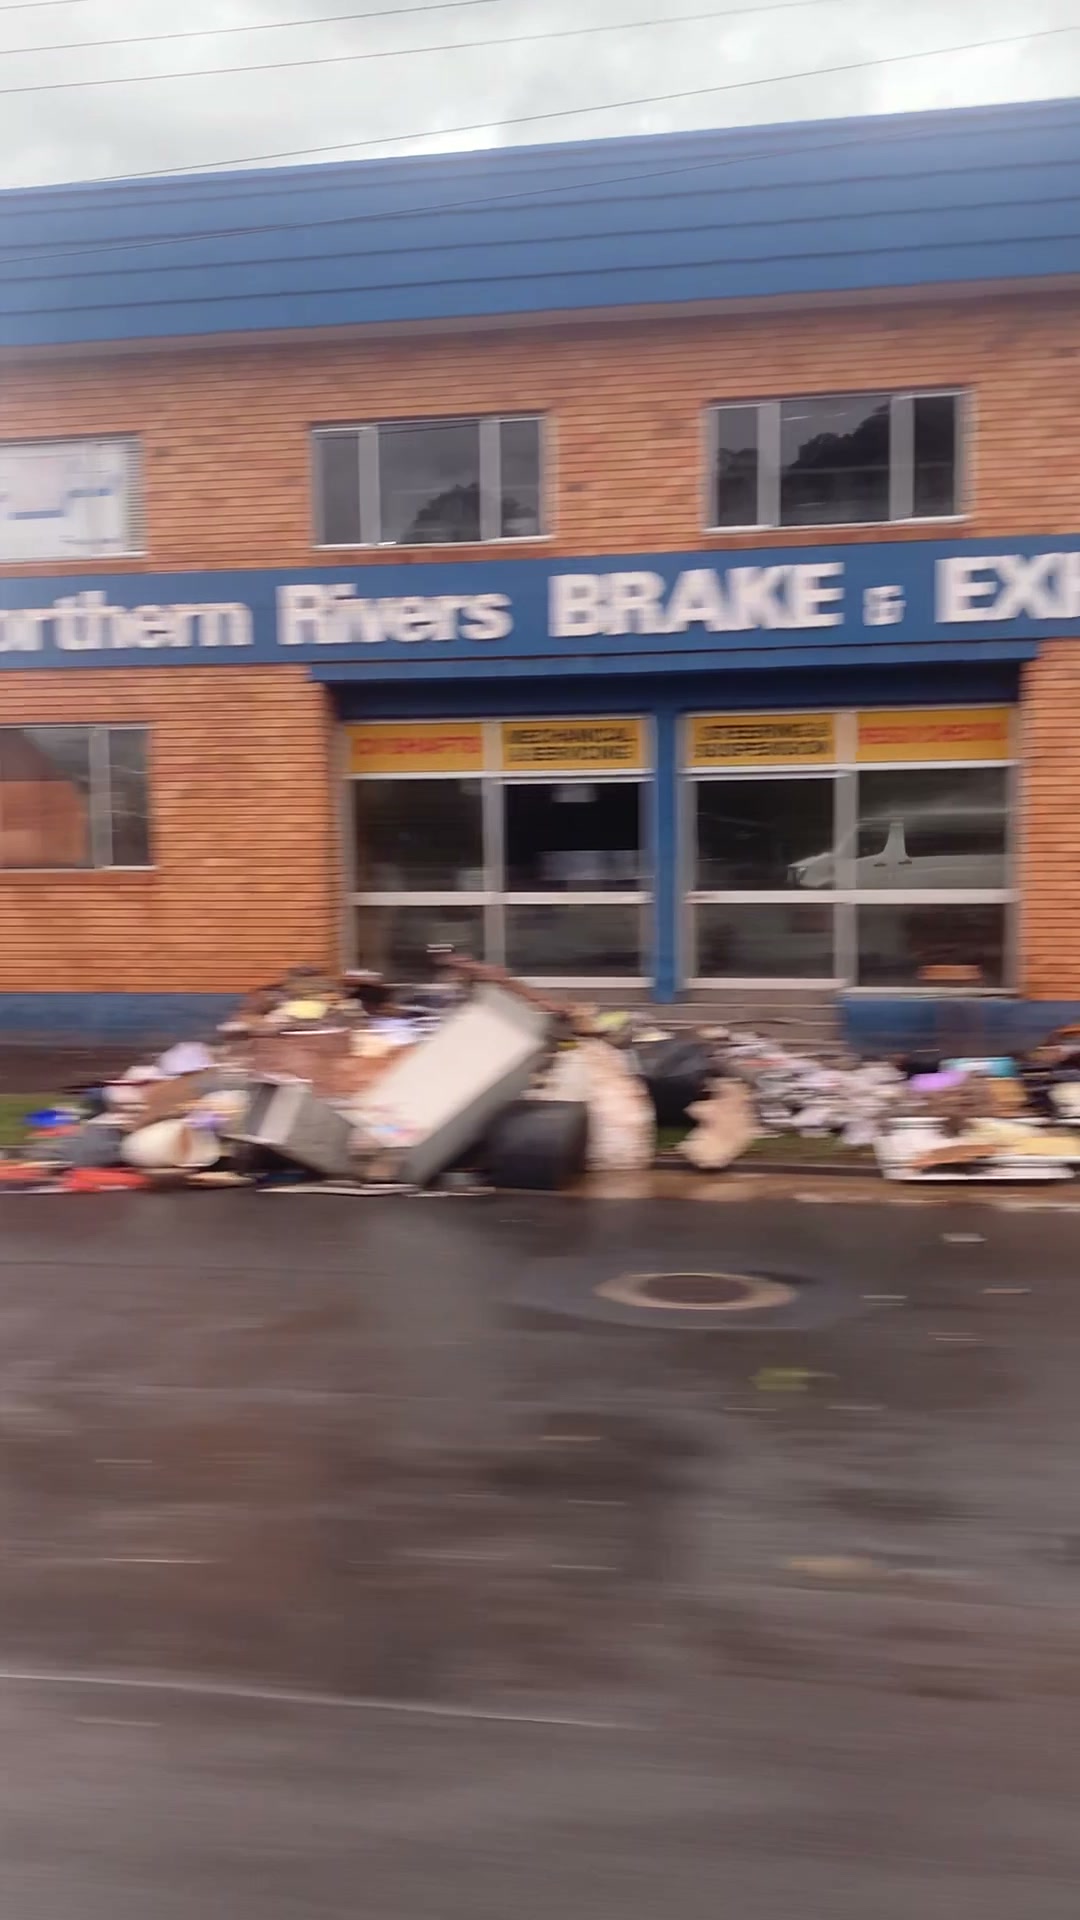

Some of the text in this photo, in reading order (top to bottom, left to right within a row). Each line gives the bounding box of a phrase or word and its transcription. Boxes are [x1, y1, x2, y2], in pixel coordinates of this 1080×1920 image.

[276, 583, 513, 645] Rivers
[548, 562, 845, 637] BRAKE
[863, 585, 904, 626] &
